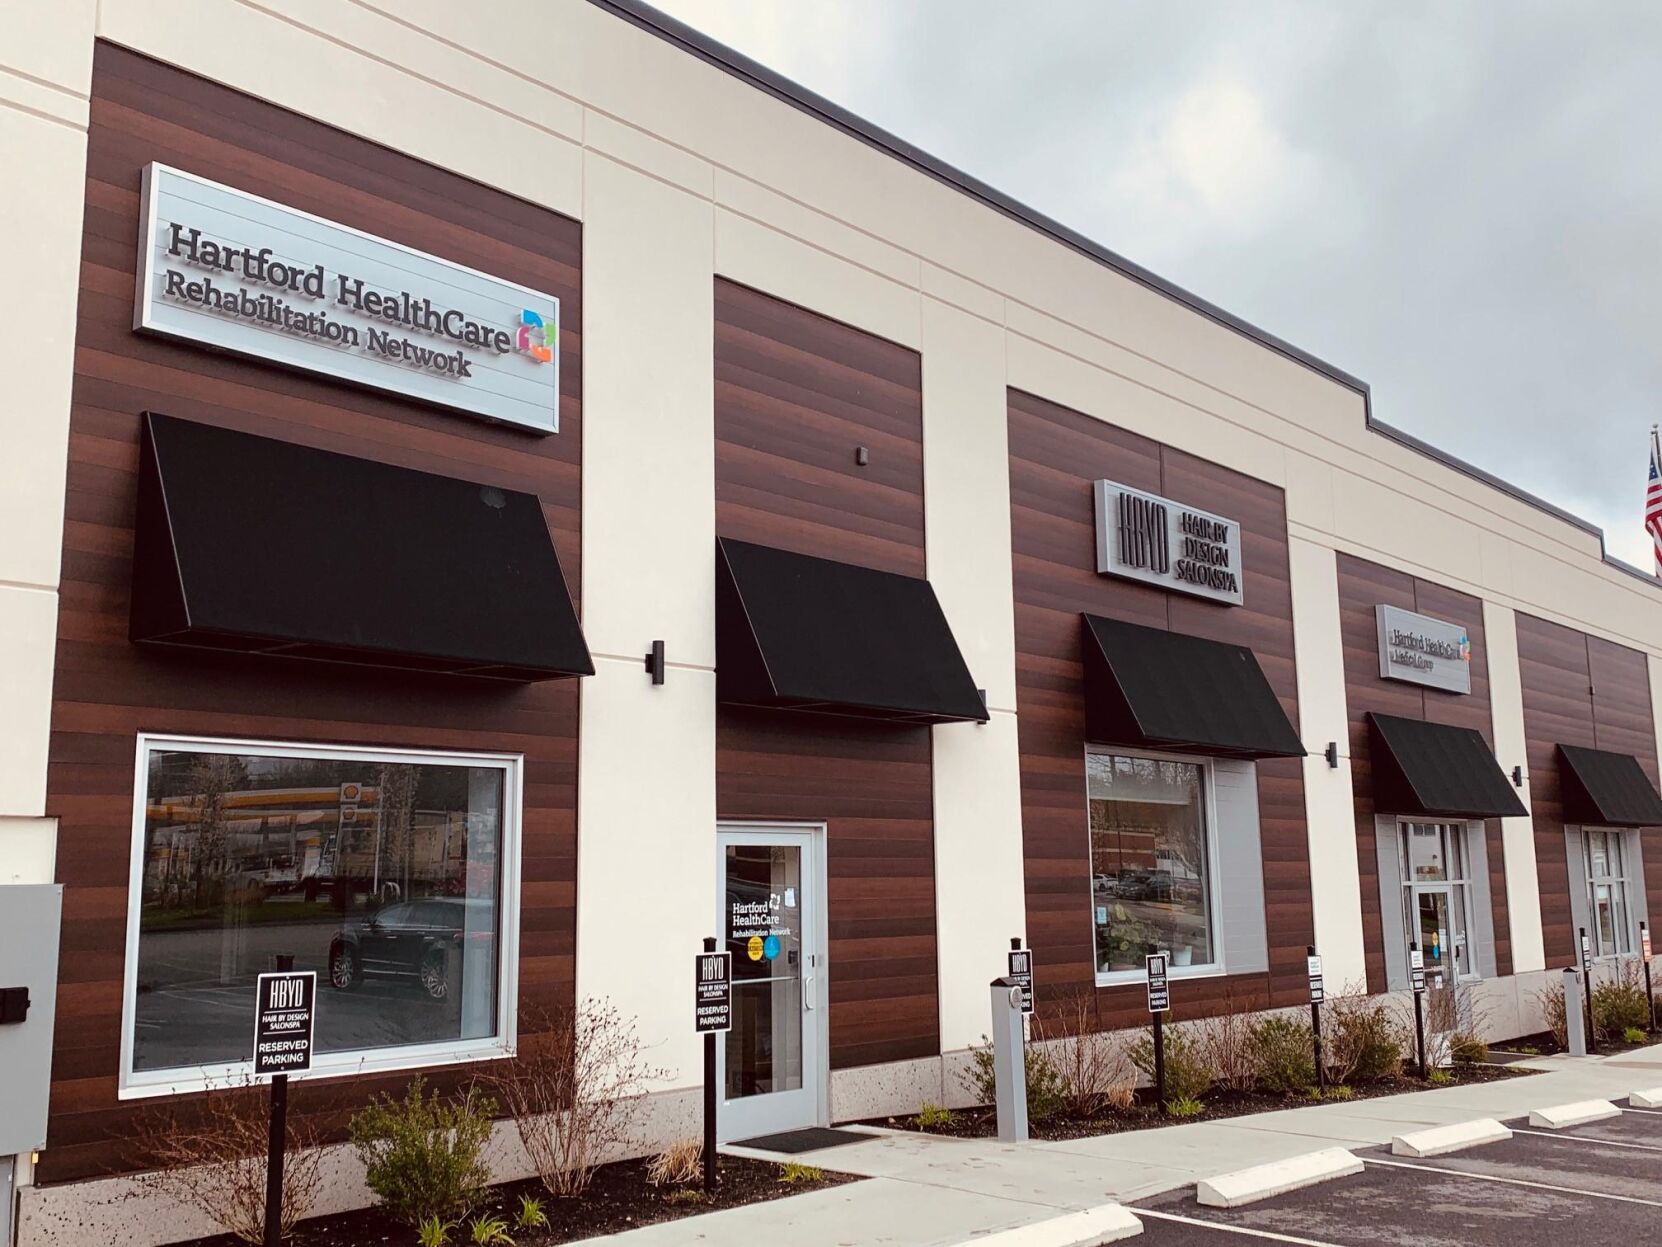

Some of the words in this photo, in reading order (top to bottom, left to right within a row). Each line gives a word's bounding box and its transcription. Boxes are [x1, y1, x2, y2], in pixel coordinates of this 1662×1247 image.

[167, 222, 325, 300] Hartford
[336, 274, 511, 354] HealthCare
[165, 270, 359, 347] Rehabilitation
[368, 327, 473, 378] Network
[1182, 511, 1212, 541] HAIR
[1213, 522, 1229, 544] BY
[1185, 537, 1229, 568] DESIGN
[1177, 559, 1238, 593] SALONSPA
[1393, 628, 1424, 650] Hartford
[732, 900, 768, 914] Hartford
[732, 914, 779, 926] HealthCare
[732, 930, 768, 938] Rehabilitation
[702, 957, 724, 981] HBYD
[269, 979, 303, 1009] HBYD
[262, 1015, 277, 1023] HAIR
[287, 1012, 309, 1021] DESIGN
[697, 1005, 729, 1016] RESERVED
[269, 1021, 300, 1030] SALONSPA
[700, 1015, 726, 1026] PARKING
[259, 1040, 308, 1053] RESERVED
[262, 1052, 303, 1066] PARKING
